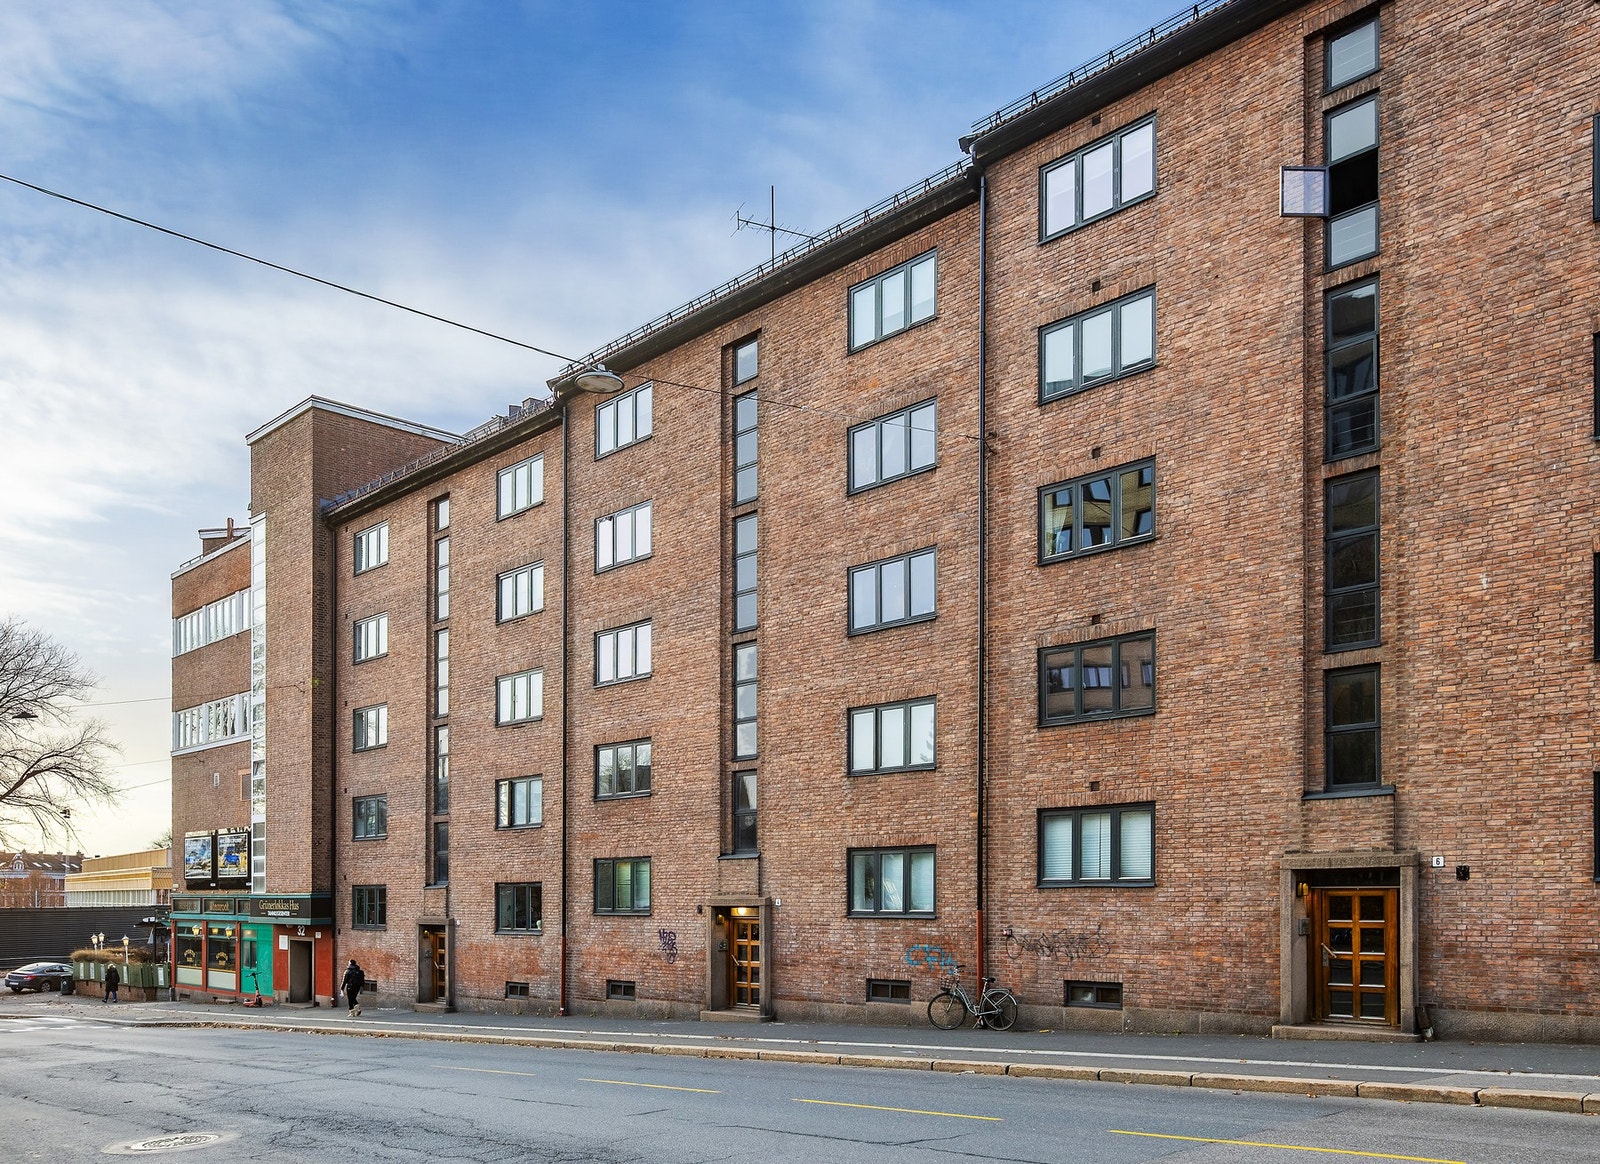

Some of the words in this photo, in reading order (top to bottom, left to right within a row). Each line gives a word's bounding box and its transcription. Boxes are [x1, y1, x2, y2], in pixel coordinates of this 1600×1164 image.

[1435, 857, 1441, 866] 6
[290, 900, 299, 910] Hus
[297, 925, 306, 936] 32
